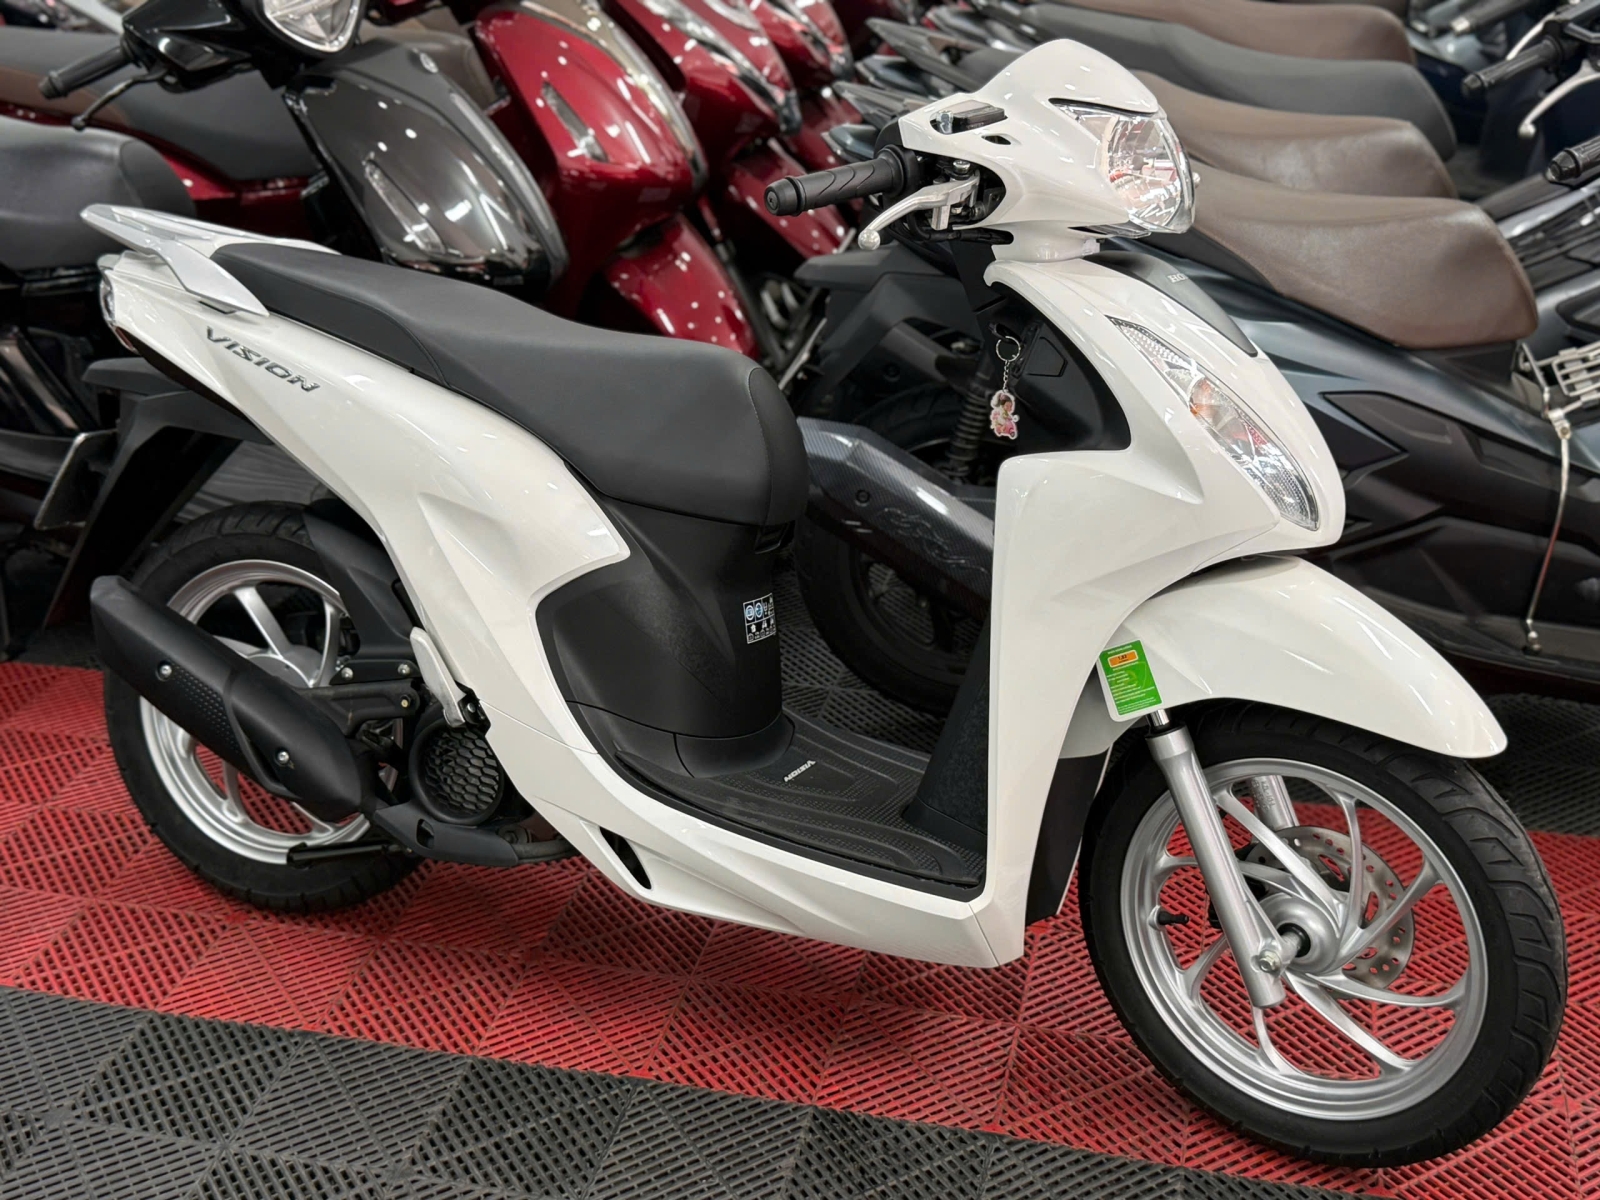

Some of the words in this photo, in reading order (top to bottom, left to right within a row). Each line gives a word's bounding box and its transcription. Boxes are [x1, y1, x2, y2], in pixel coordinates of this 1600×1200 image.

[1166, 273, 1188, 283] HO
[206, 326, 320, 392] VISION
[783, 760, 816, 782] VISION
